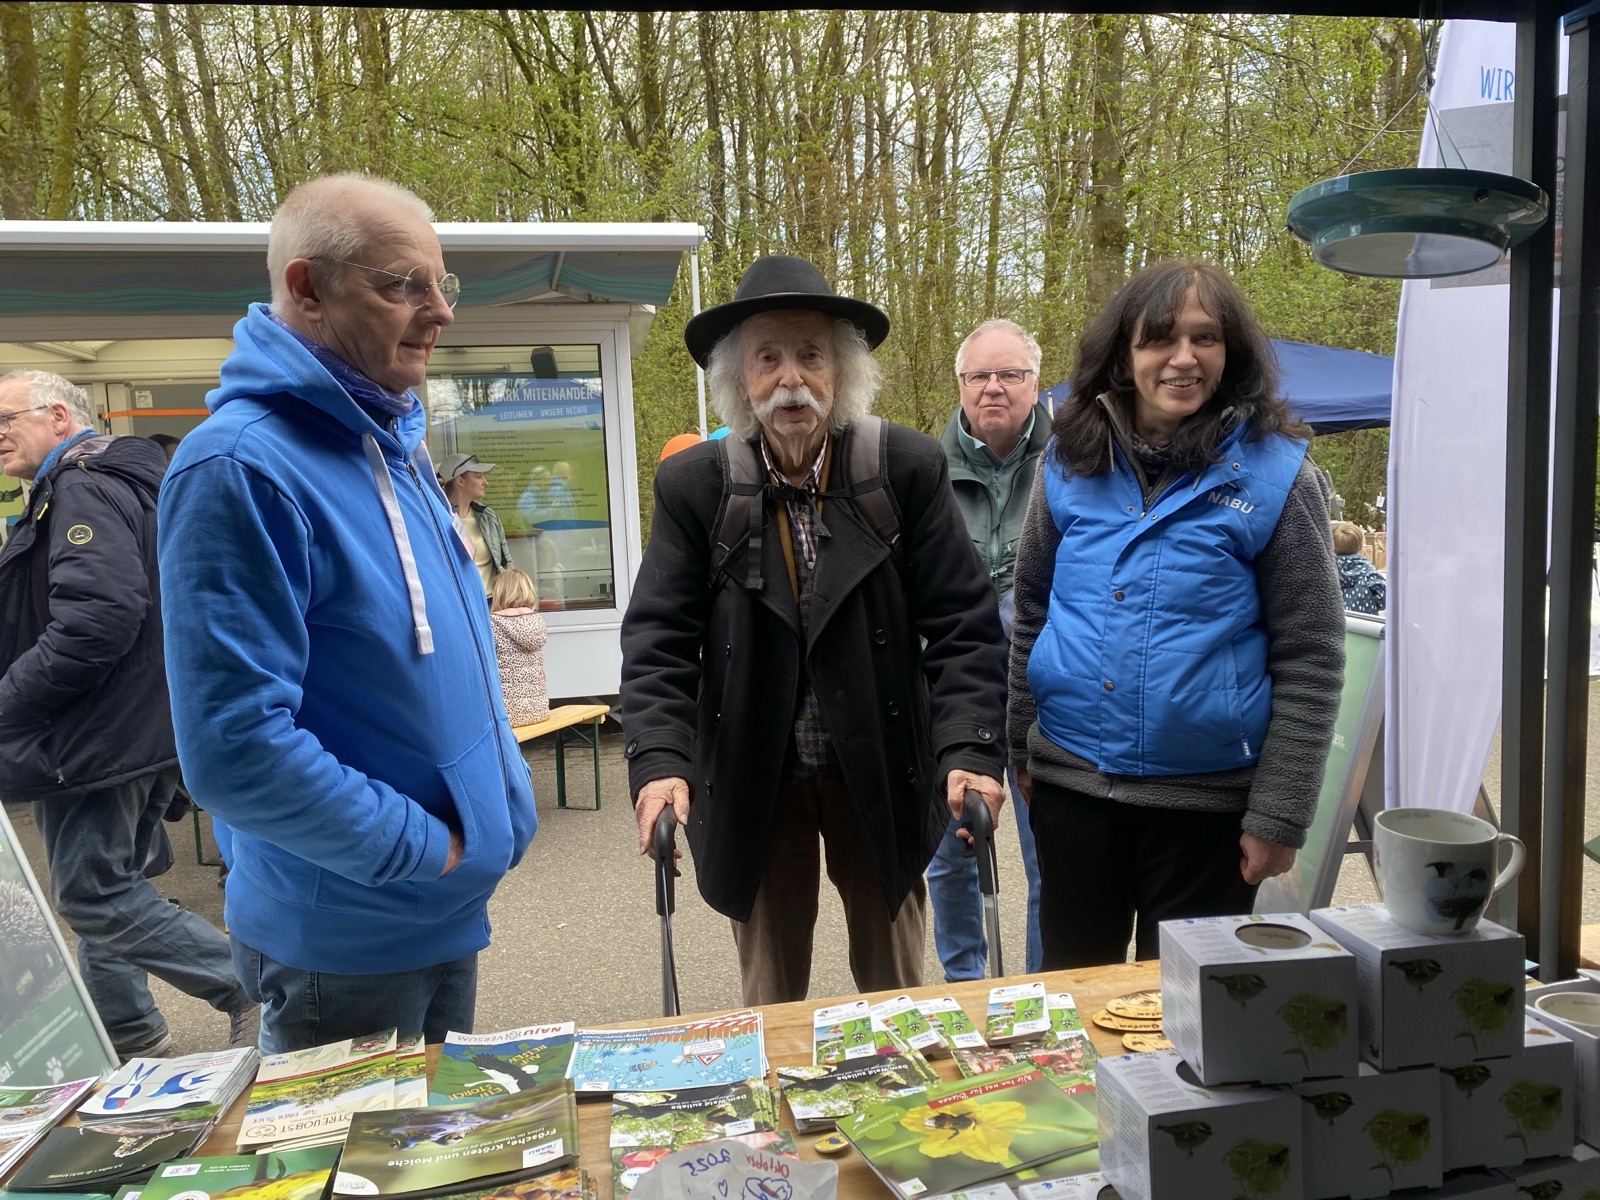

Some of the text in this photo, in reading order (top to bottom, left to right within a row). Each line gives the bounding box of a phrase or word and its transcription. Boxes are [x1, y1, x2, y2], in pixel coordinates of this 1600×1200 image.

[1480, 65, 1514, 101] WIR
[500, 410, 533, 420] LEITLINIEN
[540, 408, 563, 417] UNSERE
[565, 405, 588, 415] RECHTE
[1207, 491, 1255, 514] NABU
[457, 1026, 562, 1042] NAJU VERSUM
[508, 1044, 548, 1064] REISEN
[520, 1053, 541, 1066] AUF
[836, 1072, 867, 1080] zuliebe
[1017, 1075, 1032, 1084] Wir
[447, 1083, 493, 1101] STORCH
[479, 1086, 503, 1098] EIN
[970, 1086, 983, 1095] für
[705, 1099, 725, 1107] Wald
[938, 1092, 969, 1104] Bienen
[387, 1128, 557, 1167] Frösche, Kröten und Molche
